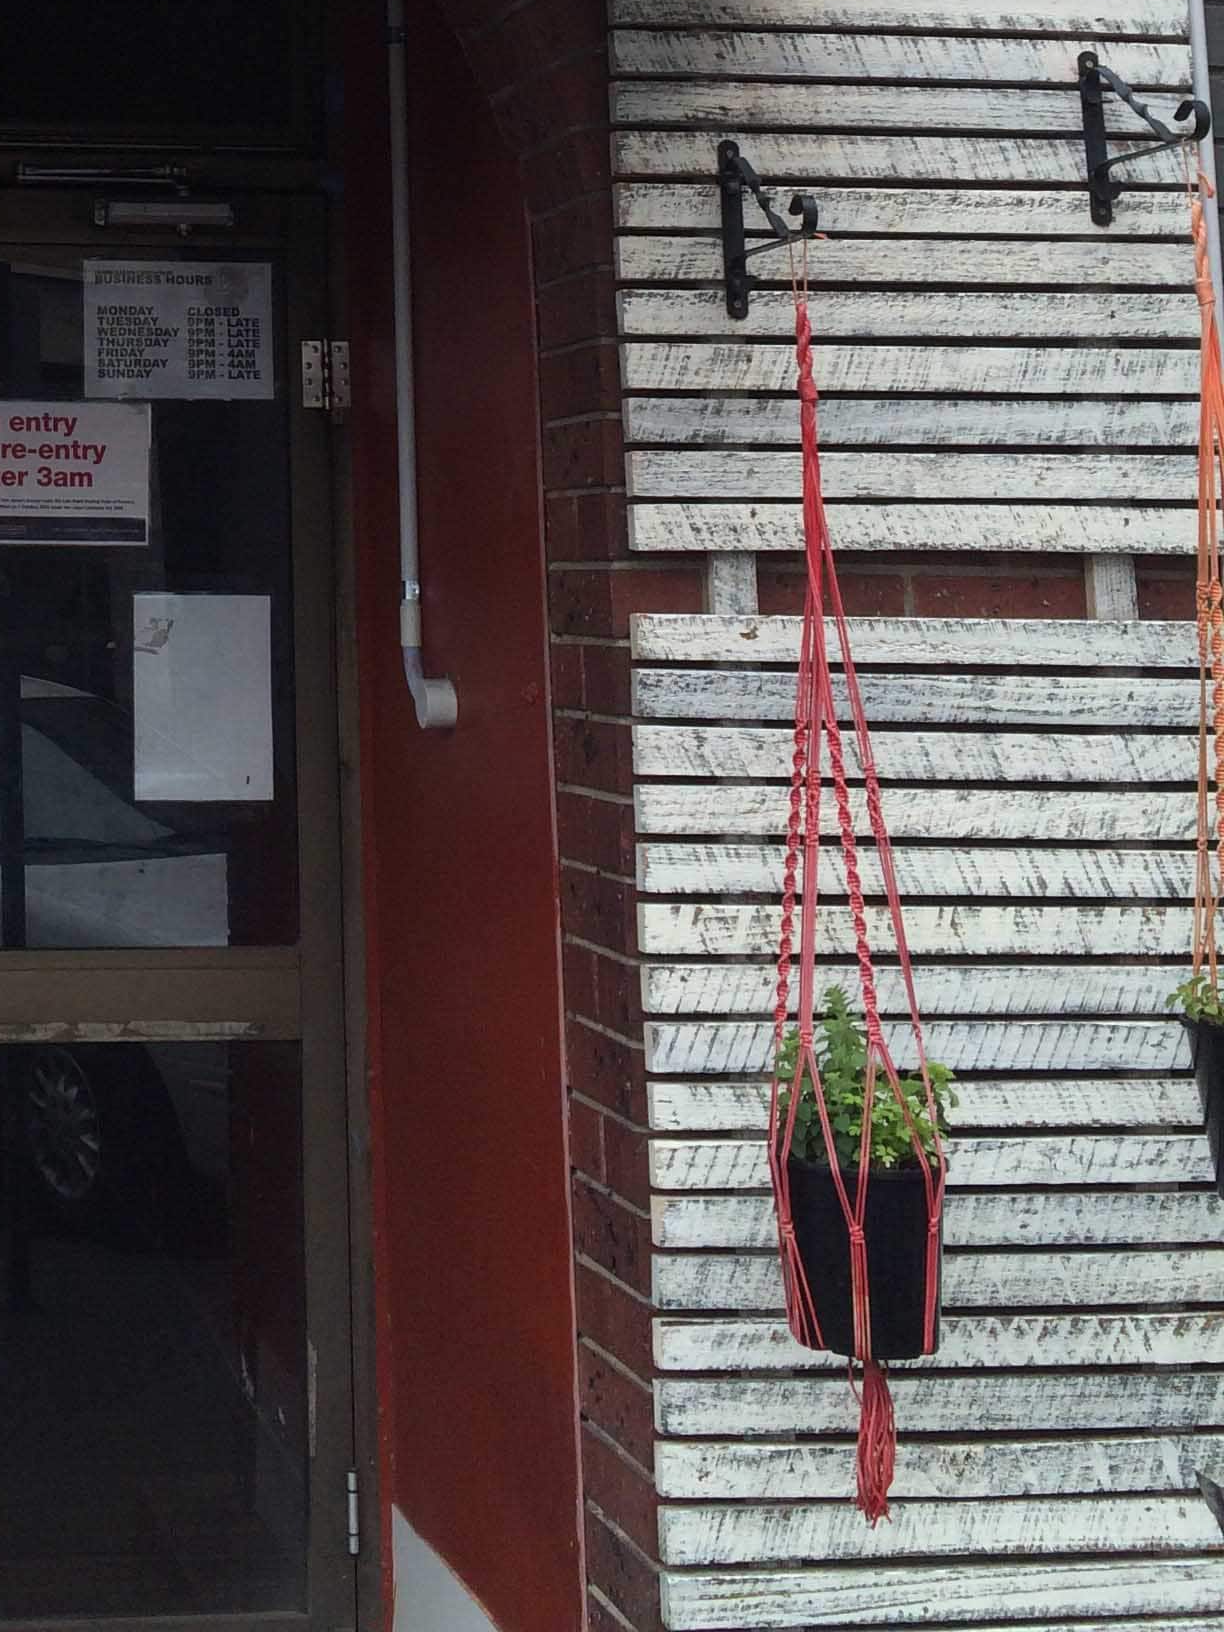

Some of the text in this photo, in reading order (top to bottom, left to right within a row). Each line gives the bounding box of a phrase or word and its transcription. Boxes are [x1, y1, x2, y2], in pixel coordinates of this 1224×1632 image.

[94, 273, 214, 287] BUSINESS HOURS
[96, 306, 241, 318] MONDAY CLOSED
[97, 317, 159, 326] TUESDAY
[227, 318, 261, 328] LATE
[97, 327, 180, 337] WEDNESDAY
[227, 329, 261, 339] LATE
[97, 338, 170, 348] THURSDAY
[227, 339, 261, 349] LATE
[97, 348, 145, 358] FRIDAY
[227, 349, 256, 359] 4AM
[97, 359, 169, 368] SATURDAY
[227, 359, 256, 369] 4AM
[97, 369, 153, 379] SUNDAY
[228, 370, 262, 380] LATE
[9, 413, 78, 437] entry
[1, 440, 107, 464] re-entry
[36, 467, 94, 487] 3am
